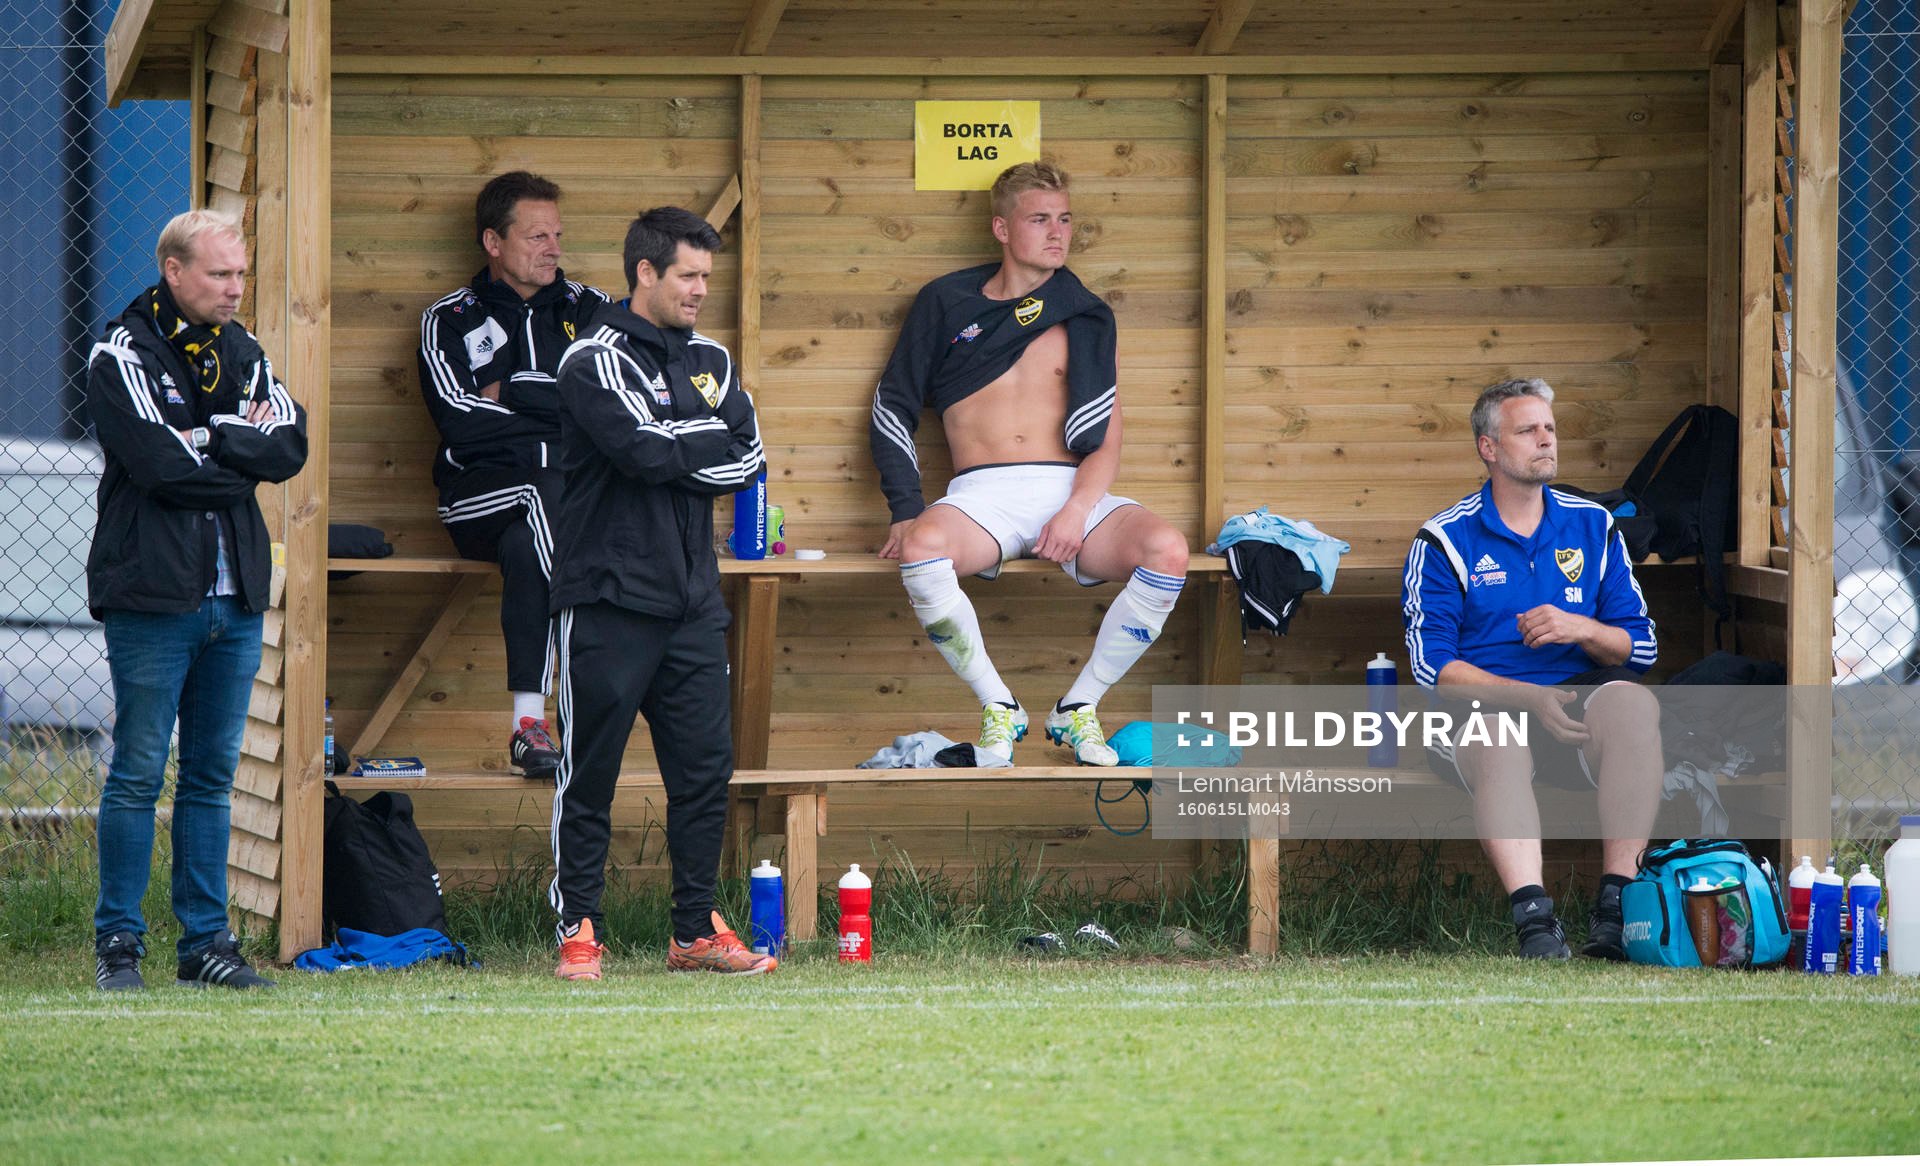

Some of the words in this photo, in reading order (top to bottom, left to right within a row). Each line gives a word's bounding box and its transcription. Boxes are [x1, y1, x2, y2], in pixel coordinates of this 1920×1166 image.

[943, 123, 1013, 138] BORTA
[957, 146, 998, 161] LAG
[757, 479, 765, 539] INTERSPORT
[1474, 563, 1500, 573] adidas
[1564, 586, 1583, 603] SN
[1856, 904, 1865, 965] INTERSPORT
